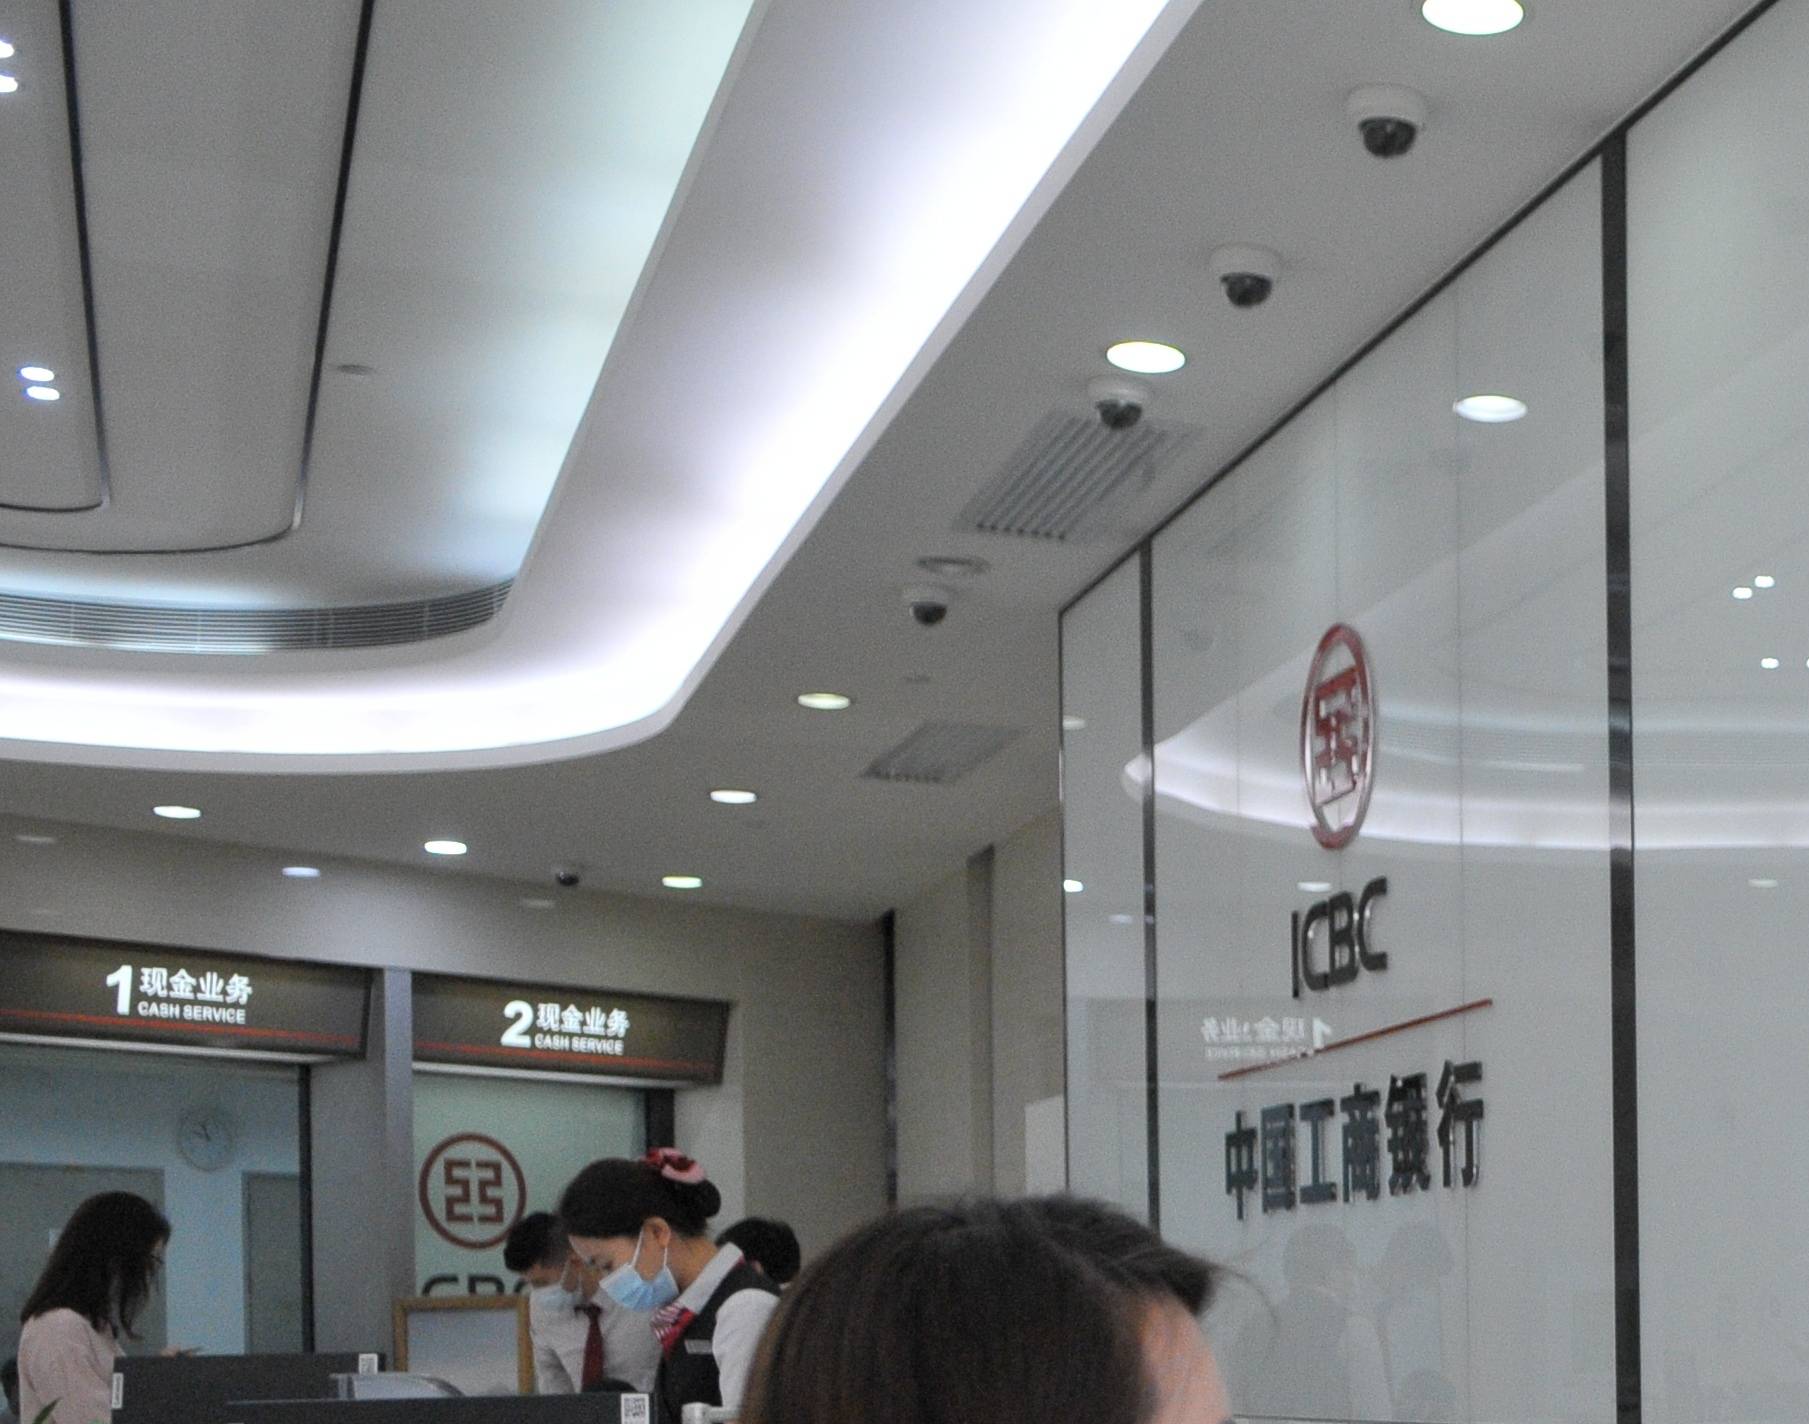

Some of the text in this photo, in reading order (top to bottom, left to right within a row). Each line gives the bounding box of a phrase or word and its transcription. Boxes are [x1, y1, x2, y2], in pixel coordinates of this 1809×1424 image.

[1290, 875, 1389, 999] ICBC
[106, 964, 253, 1016] 1 现金业务
[137, 1001, 246, 1024] CASH SERVICE
[500, 1000, 630, 1049] 2 现金业务
[534, 1033, 624, 1056] CASH SERVICE
[1224, 1059, 1484, 1221] 中国工商银行
